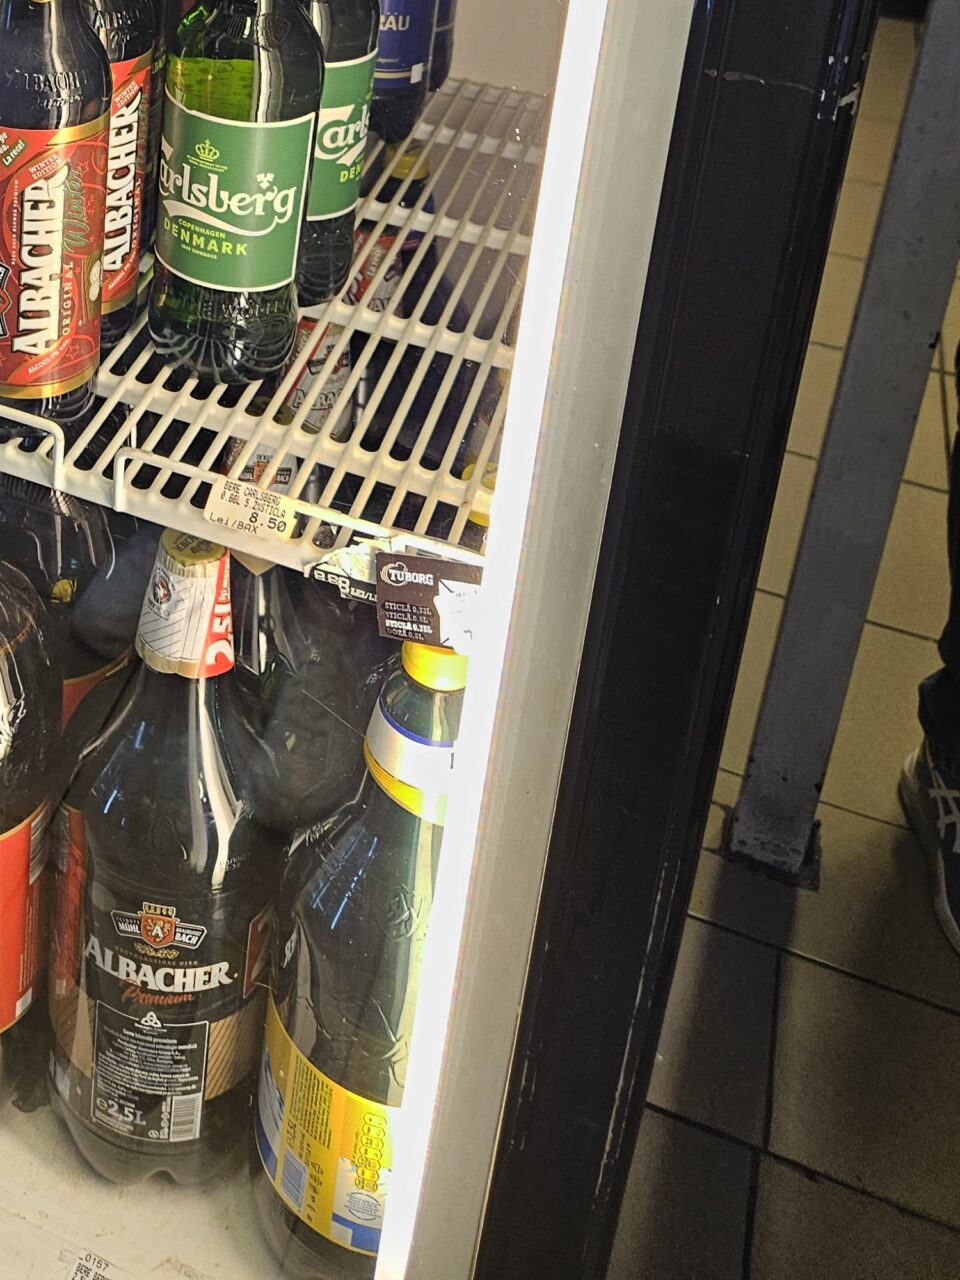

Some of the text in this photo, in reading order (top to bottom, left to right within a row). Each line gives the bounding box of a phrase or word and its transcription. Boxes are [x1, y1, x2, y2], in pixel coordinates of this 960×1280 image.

[28, 153, 59, 174] WINTER
[31, 159, 63, 182] EDITION
[102, 93, 142, 273] ALBACHER
[163, 219, 248, 257] DENMARK
[178, 218, 226, 239] COPENHAGEN
[10, 164, 70, 356] ALBACHER
[223, 480, 281, 506] BERE CARLSBERG
[209, 512, 259, 534] Lei/BAX
[248, 511, 287, 533] 8.50
[389, 569, 434, 586] TUBORG
[175, 932, 198, 945] BACH
[84, 934, 234, 993] ALBACHER
